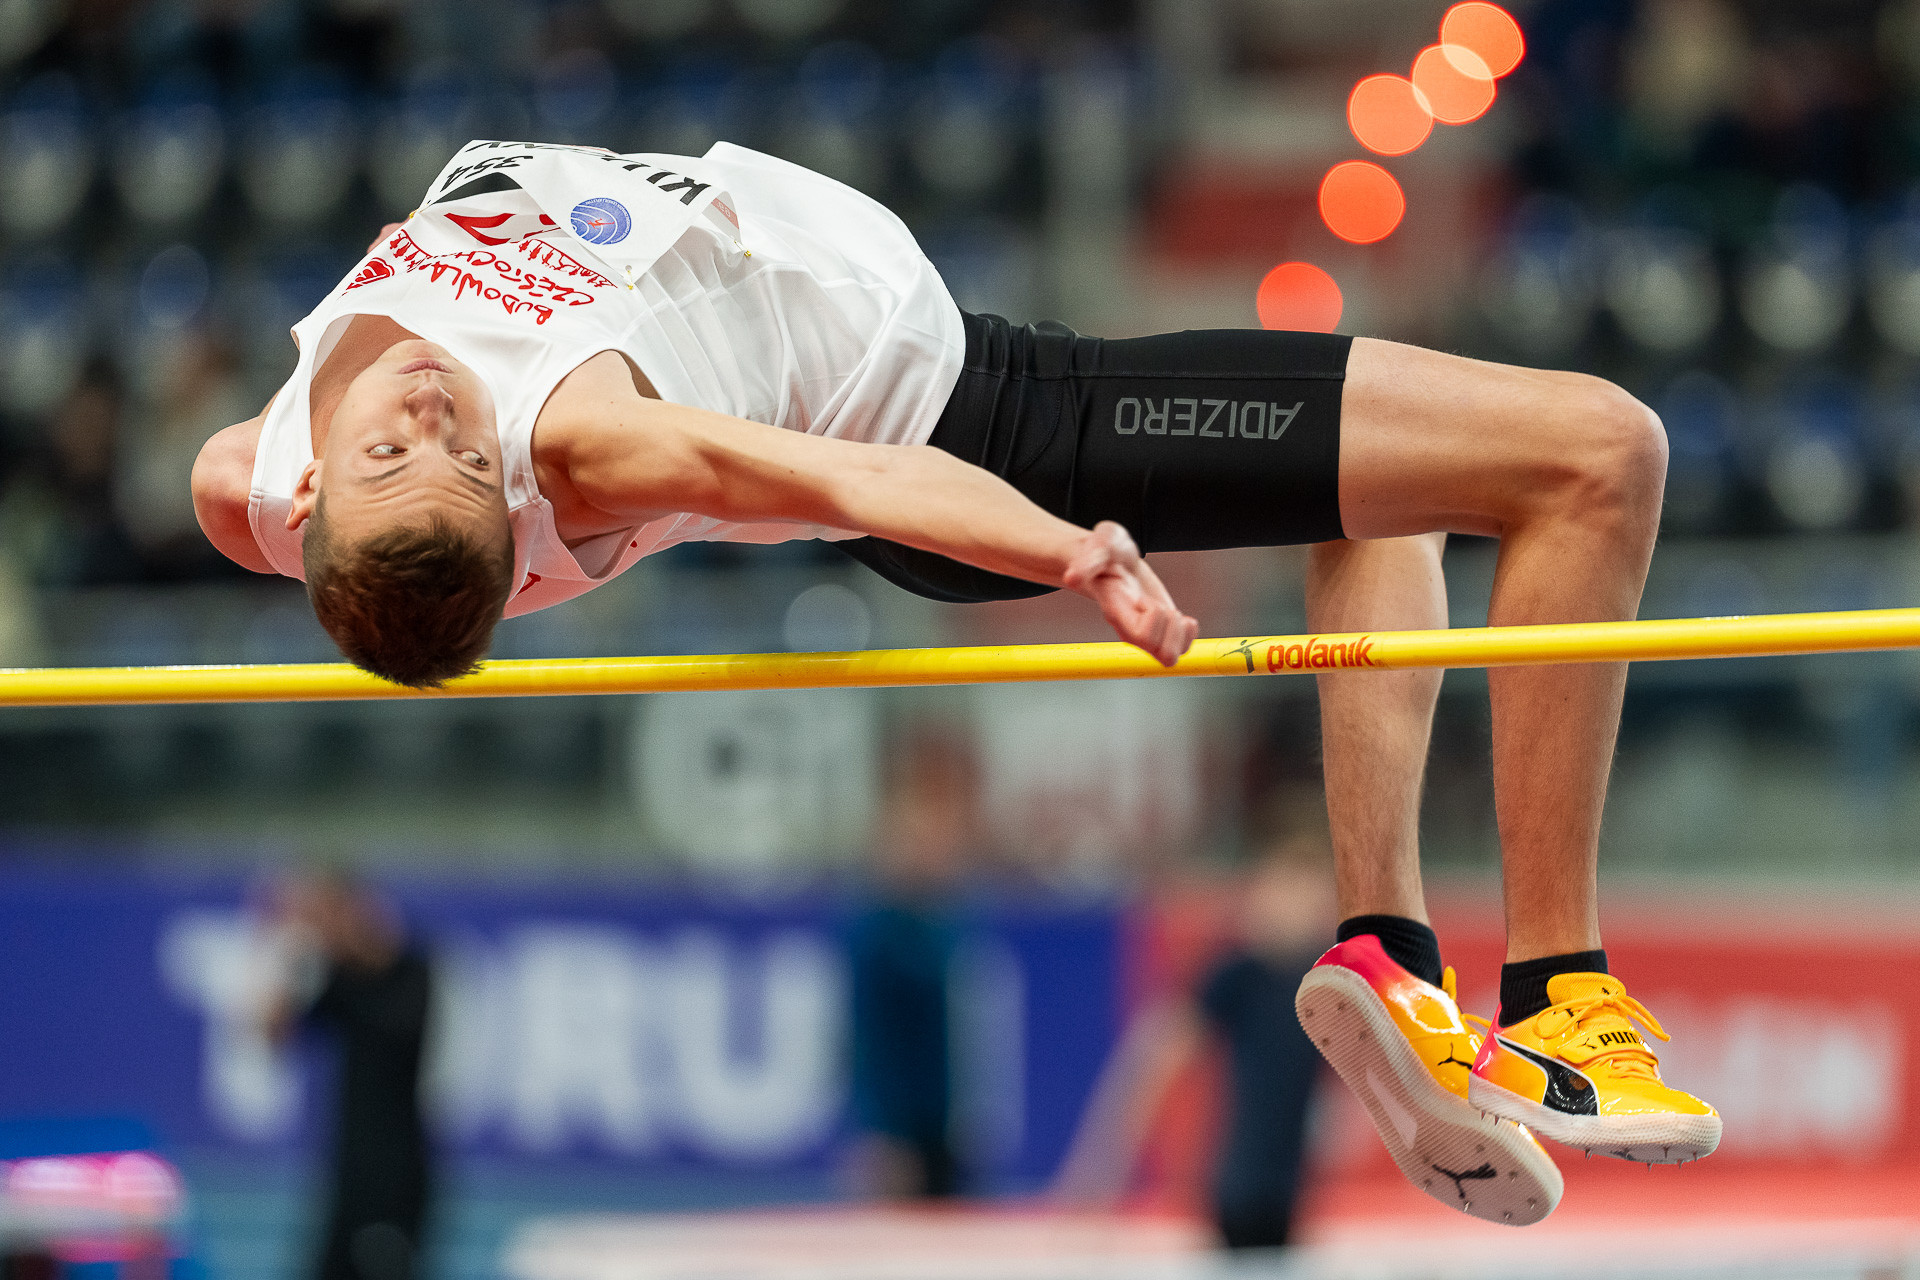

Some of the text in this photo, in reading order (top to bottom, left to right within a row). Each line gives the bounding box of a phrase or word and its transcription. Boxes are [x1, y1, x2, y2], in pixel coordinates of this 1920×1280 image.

[439, 155, 533, 193] 354
[418, 262, 554, 325] BUDOWLA
[1114, 397, 1305, 440] ADIZERO
[1266, 635, 1375, 674] polanik
[1597, 1031, 1640, 1047] PUM
